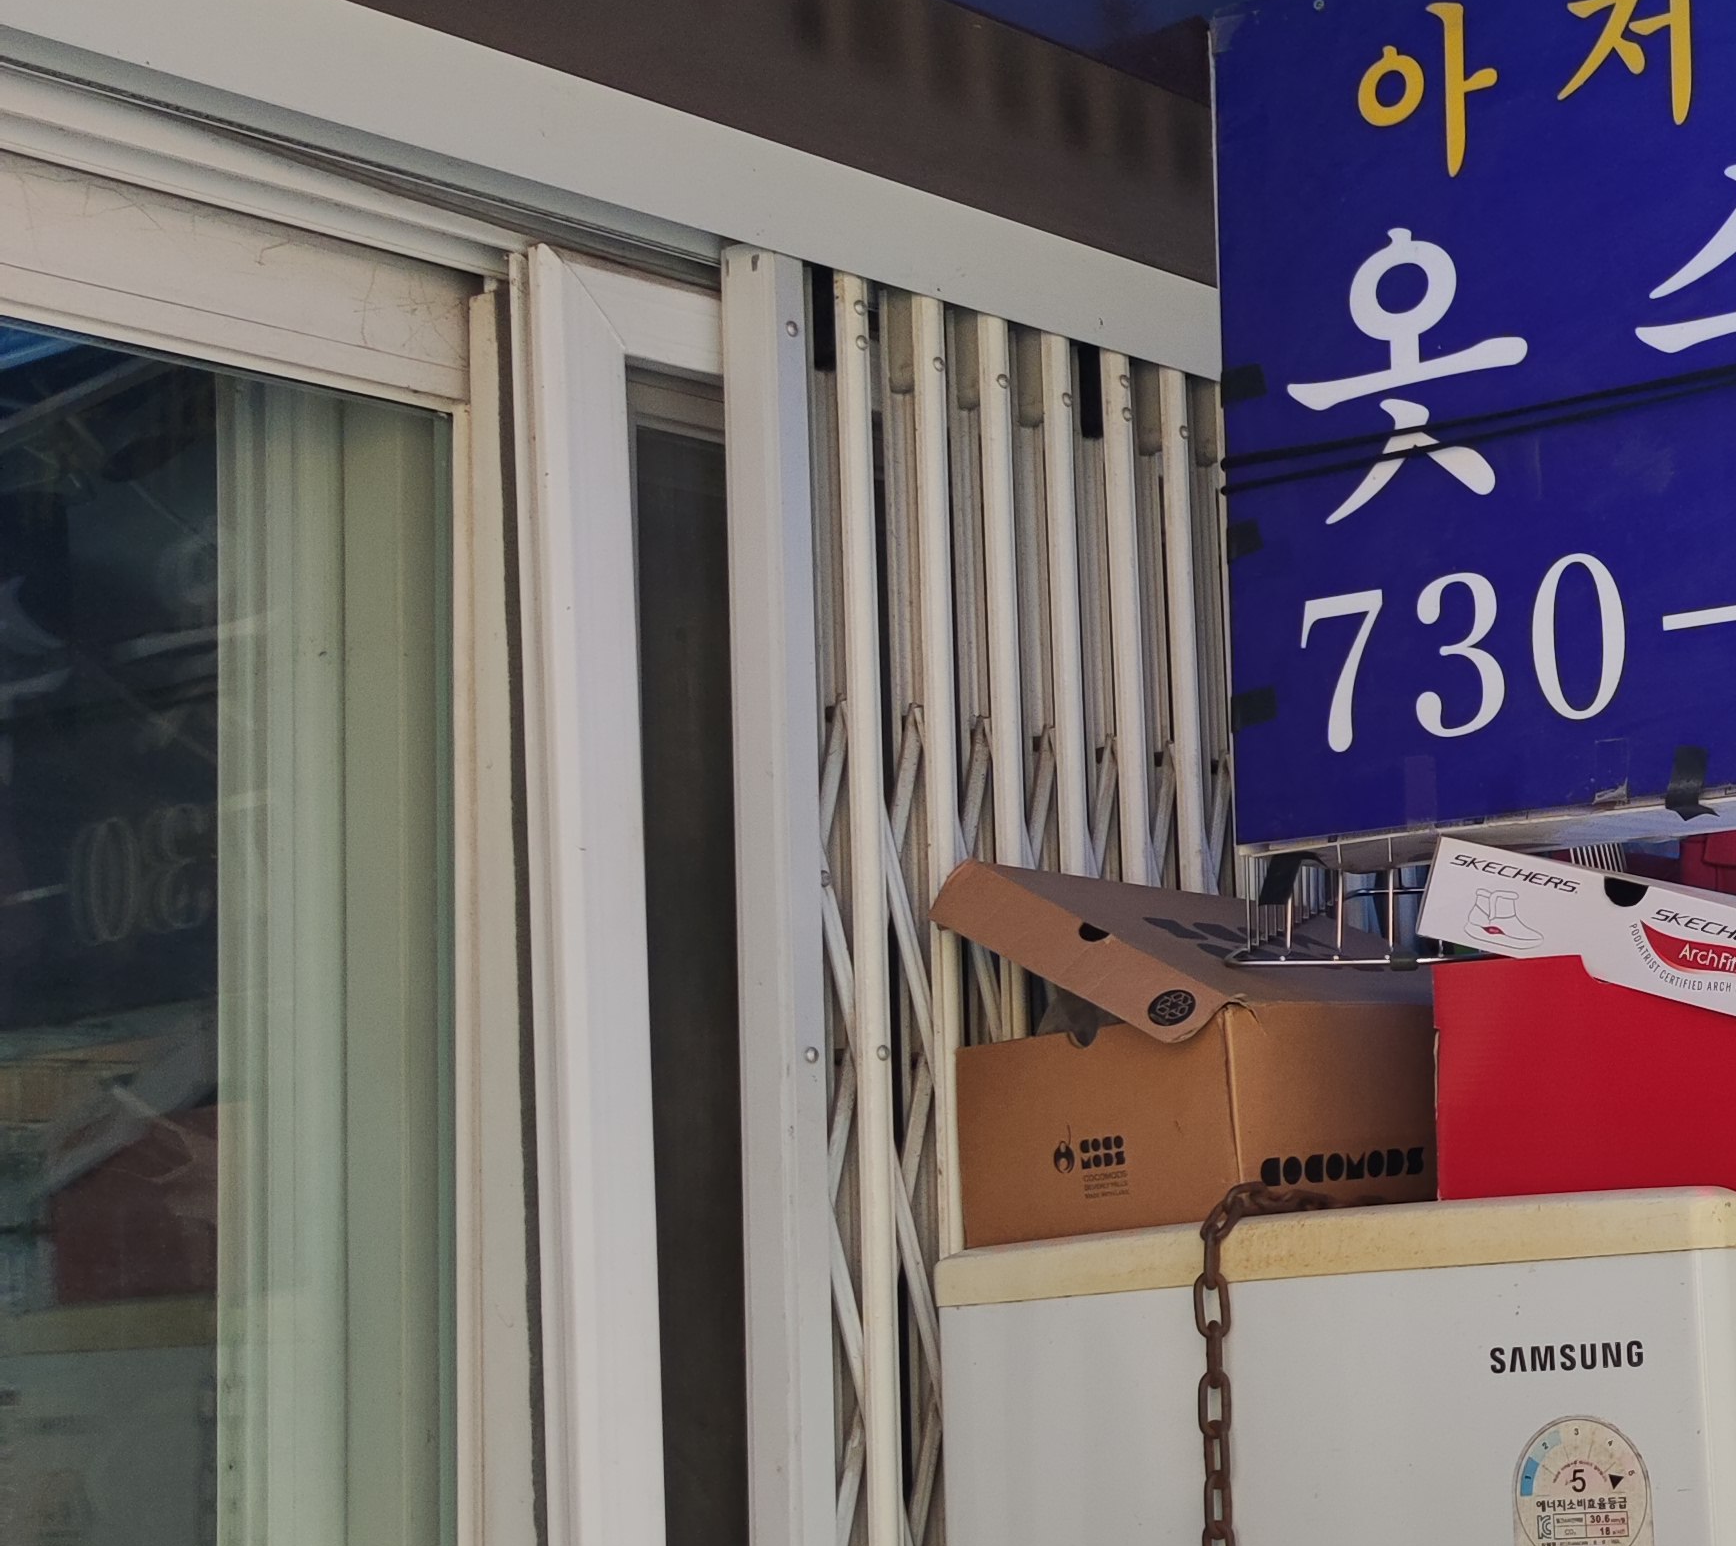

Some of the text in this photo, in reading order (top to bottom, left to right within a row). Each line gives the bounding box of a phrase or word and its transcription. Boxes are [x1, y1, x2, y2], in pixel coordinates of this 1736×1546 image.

[1449, 853, 1581, 895] SKECHERS
[1628, 922, 1660, 974] PODIATRIST
[1659, 969, 1703, 992] CERTIFIED
[1707, 980, 1732, 993] ARCH
[1490, 1340, 1643, 1374] SAMSUNG
[1574, 1428, 1579, 1436] 3
[1542, 1441, 1549, 1450] 2
[1572, 1469, 1586, 1492] 5
[1536, 1497, 1627, 1513] 에너지소비효율등급
[1589, 1515, 1610, 1524] 30.6
